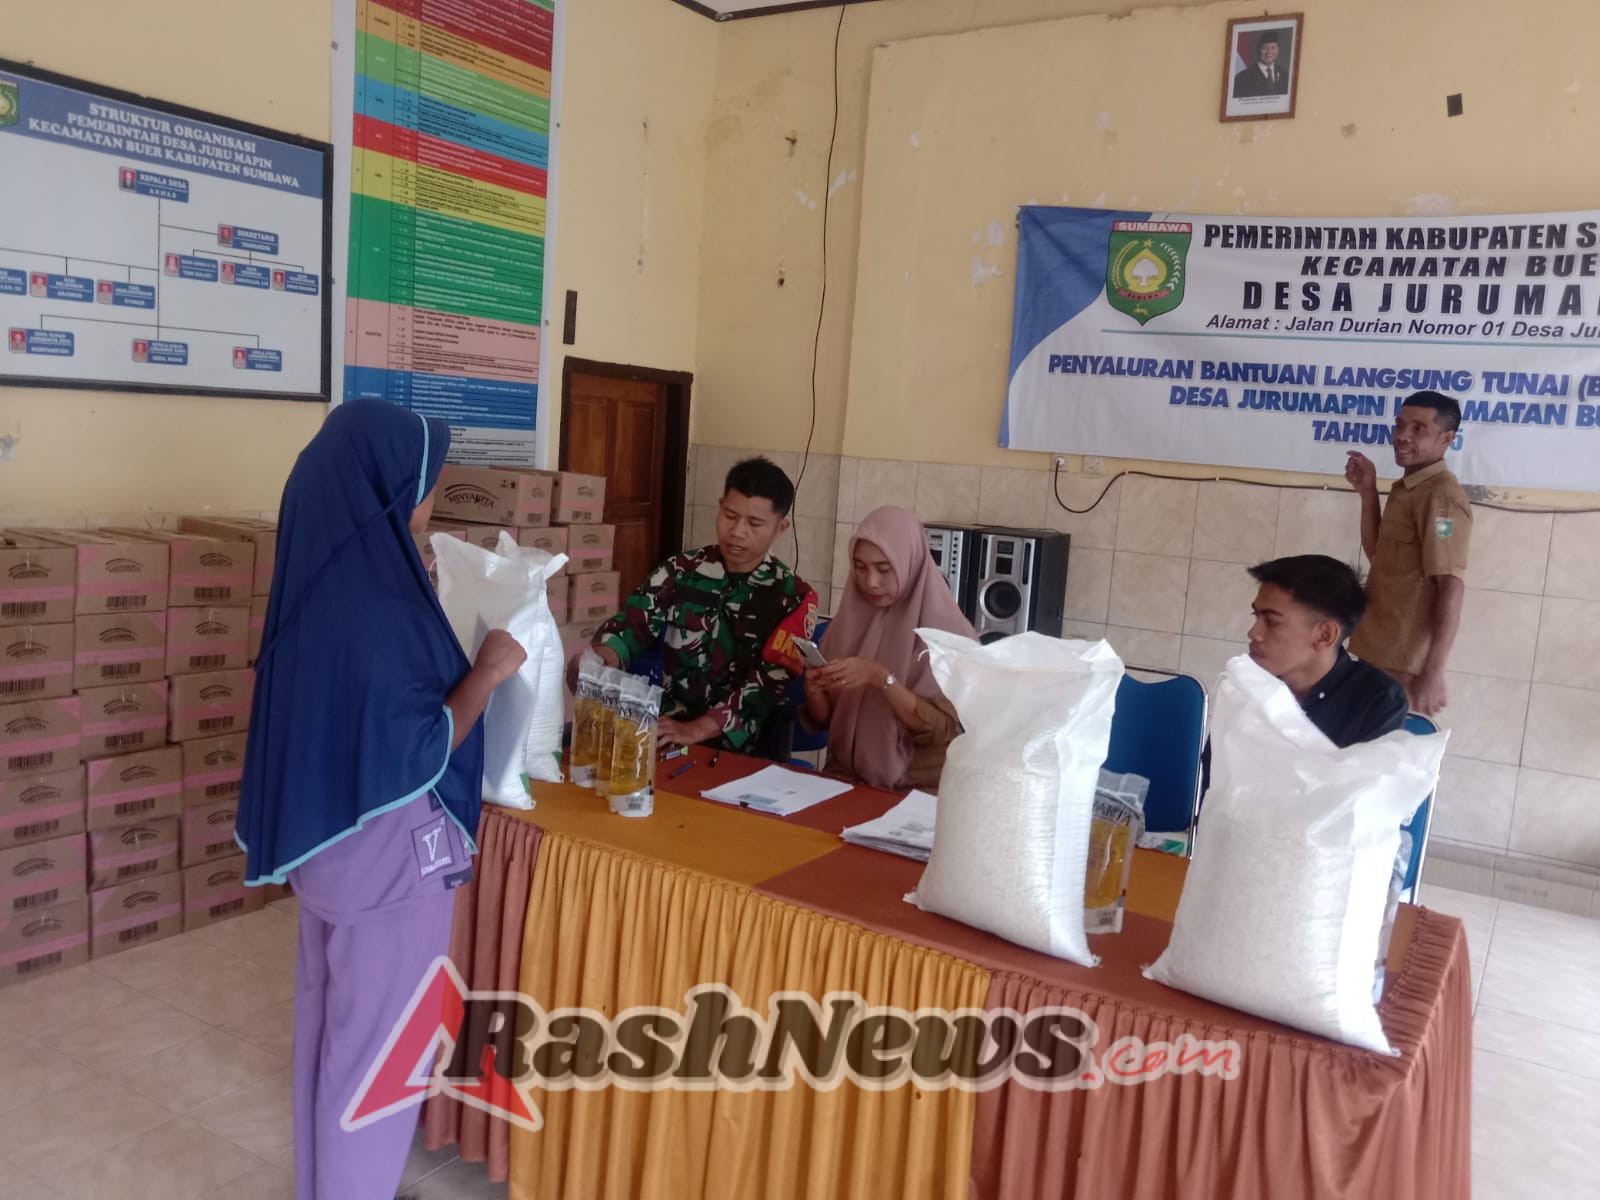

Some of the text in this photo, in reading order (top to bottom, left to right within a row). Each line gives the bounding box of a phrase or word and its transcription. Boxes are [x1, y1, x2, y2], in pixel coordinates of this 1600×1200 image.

[67, 112, 272, 169] PEMERINTAH DESA JURU MAPIN
[89, 103, 257, 153] STRUKTUR ORGANISASI
[28, 117, 300, 188] KECAMATAN BUER KABUPATEN SUMBAWA
[1118, 221, 1190, 232] SUMBAWA
[1203, 221, 1600, 250] PEMERINTAH KABUPATEN S
[1300, 255, 1507, 277] KECAMATAN
[1242, 281, 1600, 316] DESA JURUMA
[1206, 314, 1269, 330] Alamat
[1285, 316, 1334, 332] Jalan
[1339, 318, 1401, 334] Durian
[1408, 319, 1477, 336] Nomor
[1481, 321, 1505, 337] 01
[1511, 321, 1564, 338] Desa
[1048, 354, 1194, 380] PENYALURAN
[1200, 360, 1317, 386] BANTUAN
[1323, 365, 1473, 393] LANGSUNG
[1482, 371, 1570, 397] TUNAI
[1169, 385, 1229, 408] DESA
[1237, 389, 1386, 417] JURUMAPIN
[1311, 420, 1394, 446] TAHUN
